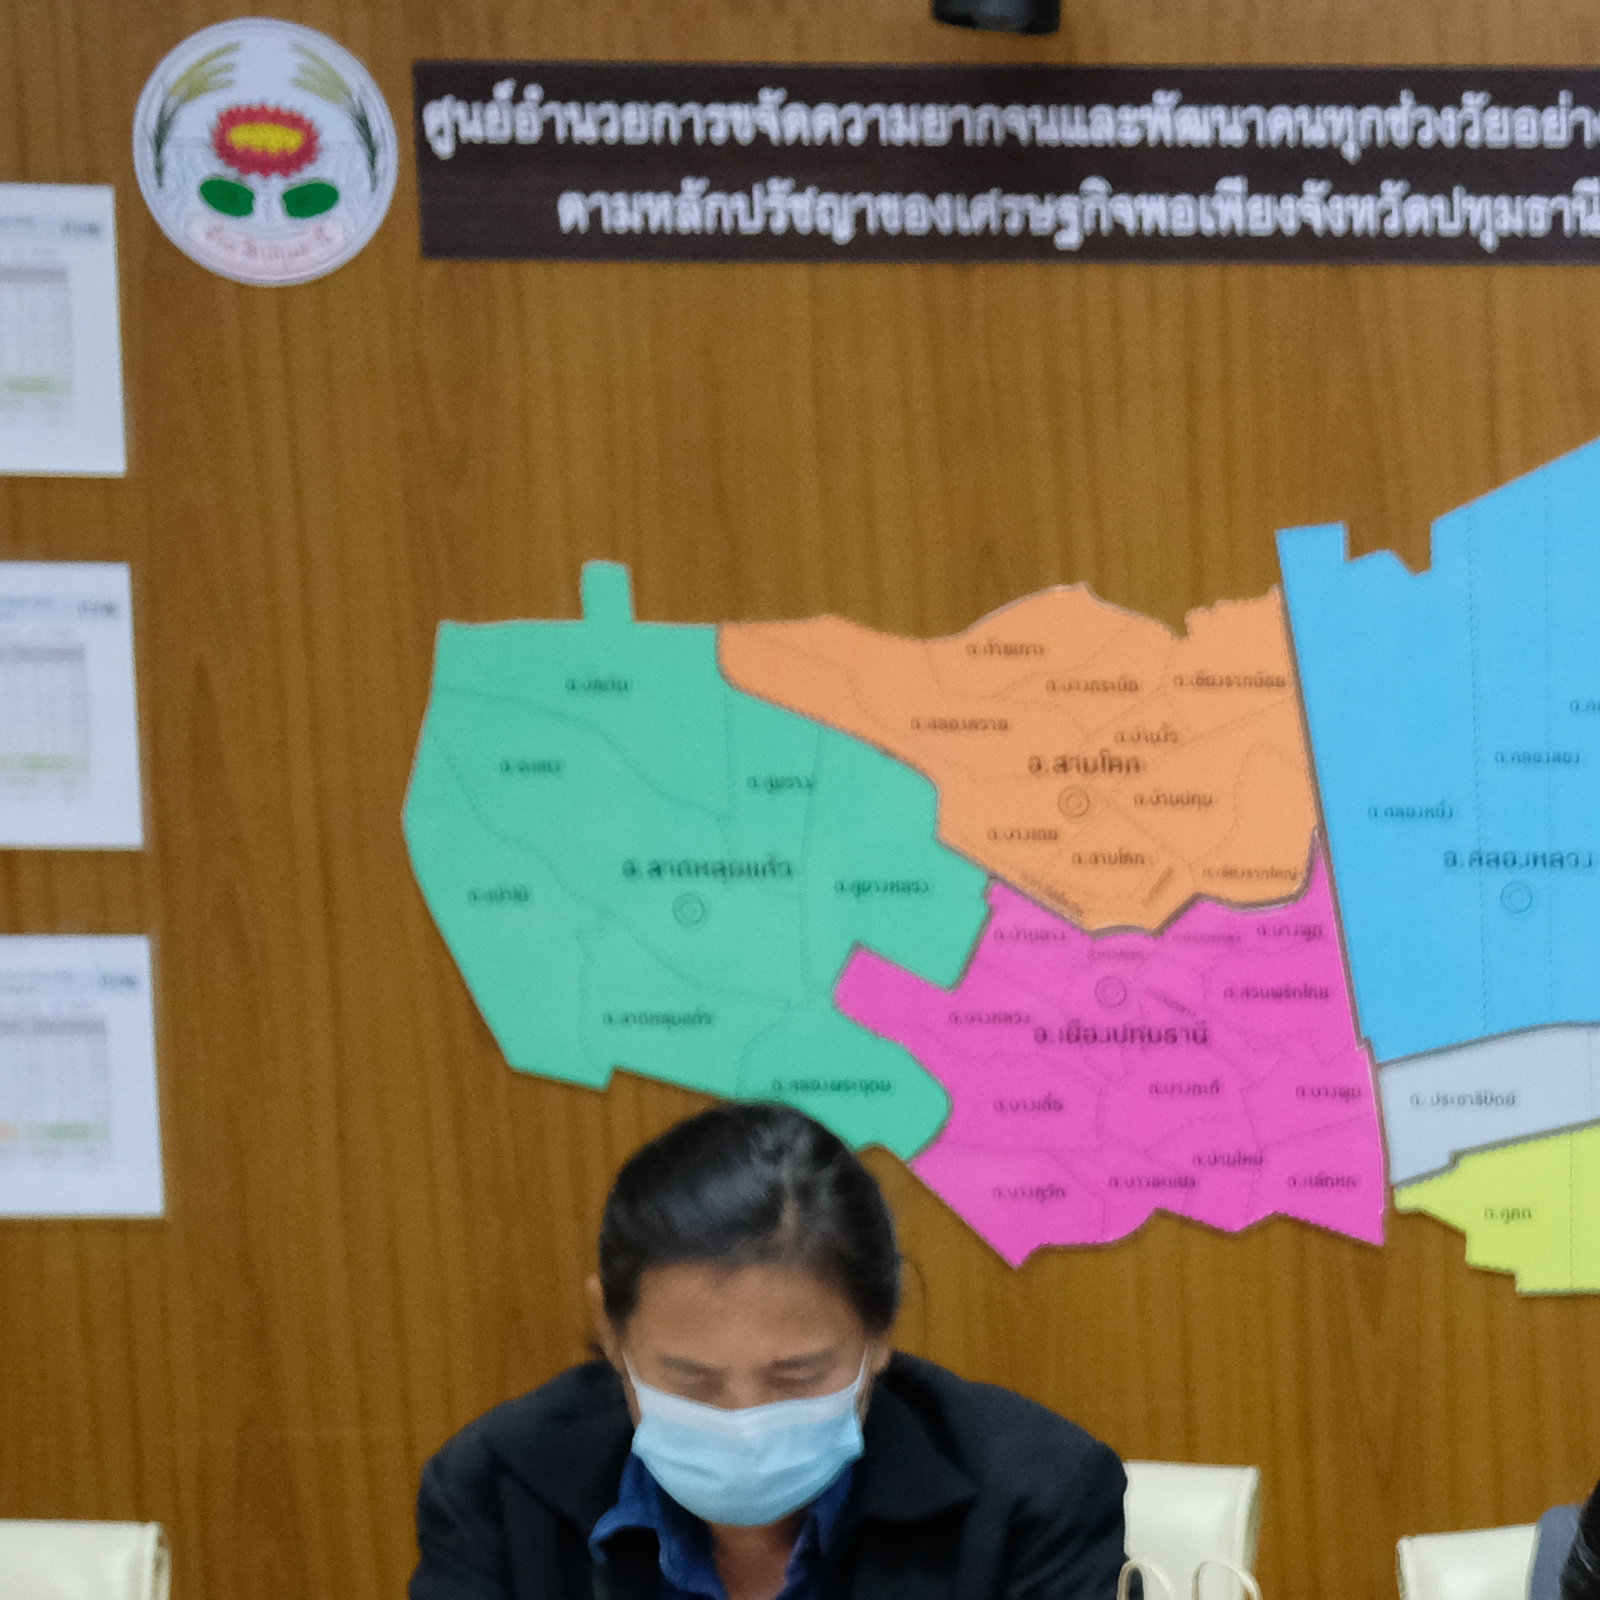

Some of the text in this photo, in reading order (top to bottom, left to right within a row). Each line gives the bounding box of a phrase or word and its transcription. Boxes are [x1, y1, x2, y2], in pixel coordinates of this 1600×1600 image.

[1028, 749, 1142, 776] อ.สามโคก
[1444, 849, 1593, 869] อ.คลองหลวง
